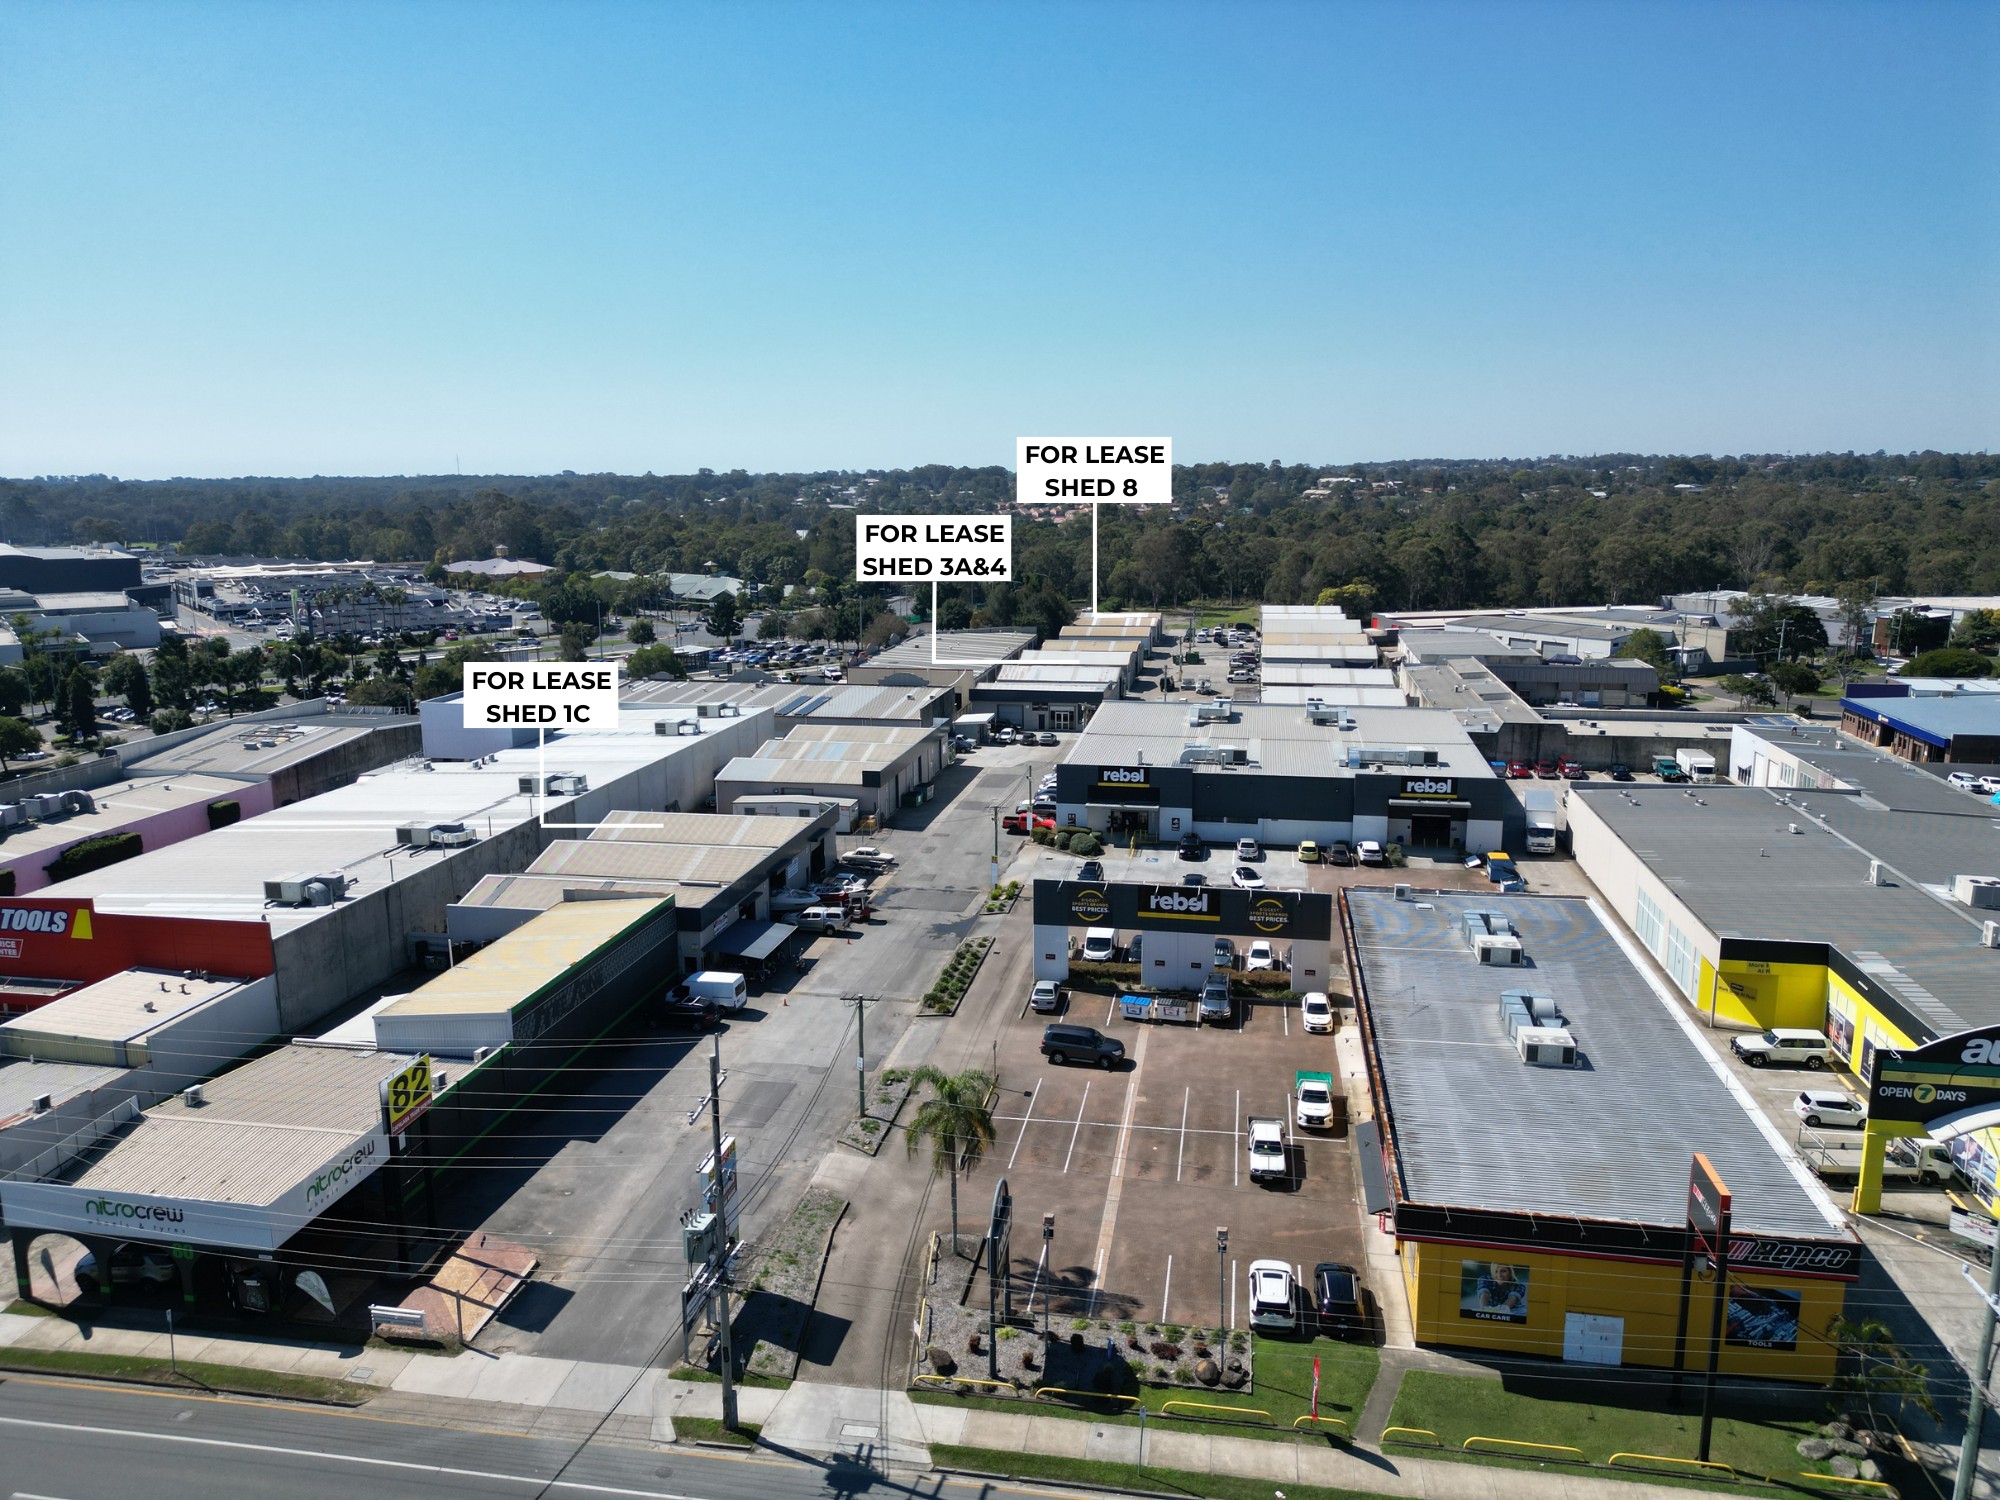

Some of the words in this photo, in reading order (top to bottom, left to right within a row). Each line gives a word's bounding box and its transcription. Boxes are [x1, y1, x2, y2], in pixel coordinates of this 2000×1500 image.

[1103, 768, 1144, 782] rebel
[1407, 778, 1452, 793] rebel
[1150, 892, 1208, 912] rebel
[0, 908, 68, 933] TOOLS
[393, 1061, 429, 1114] 82
[1879, 1086, 1912, 1098] OPEN
[1917, 1088, 1932, 1100] 7
[1936, 1090, 1967, 1102] DAYS
[307, 1139, 375, 1203] nitrocrew
[86, 1196, 184, 1223] nitrocrew
[1750, 1239, 1852, 1269] Repco
[1491, 1314, 1511, 1322] CARE
